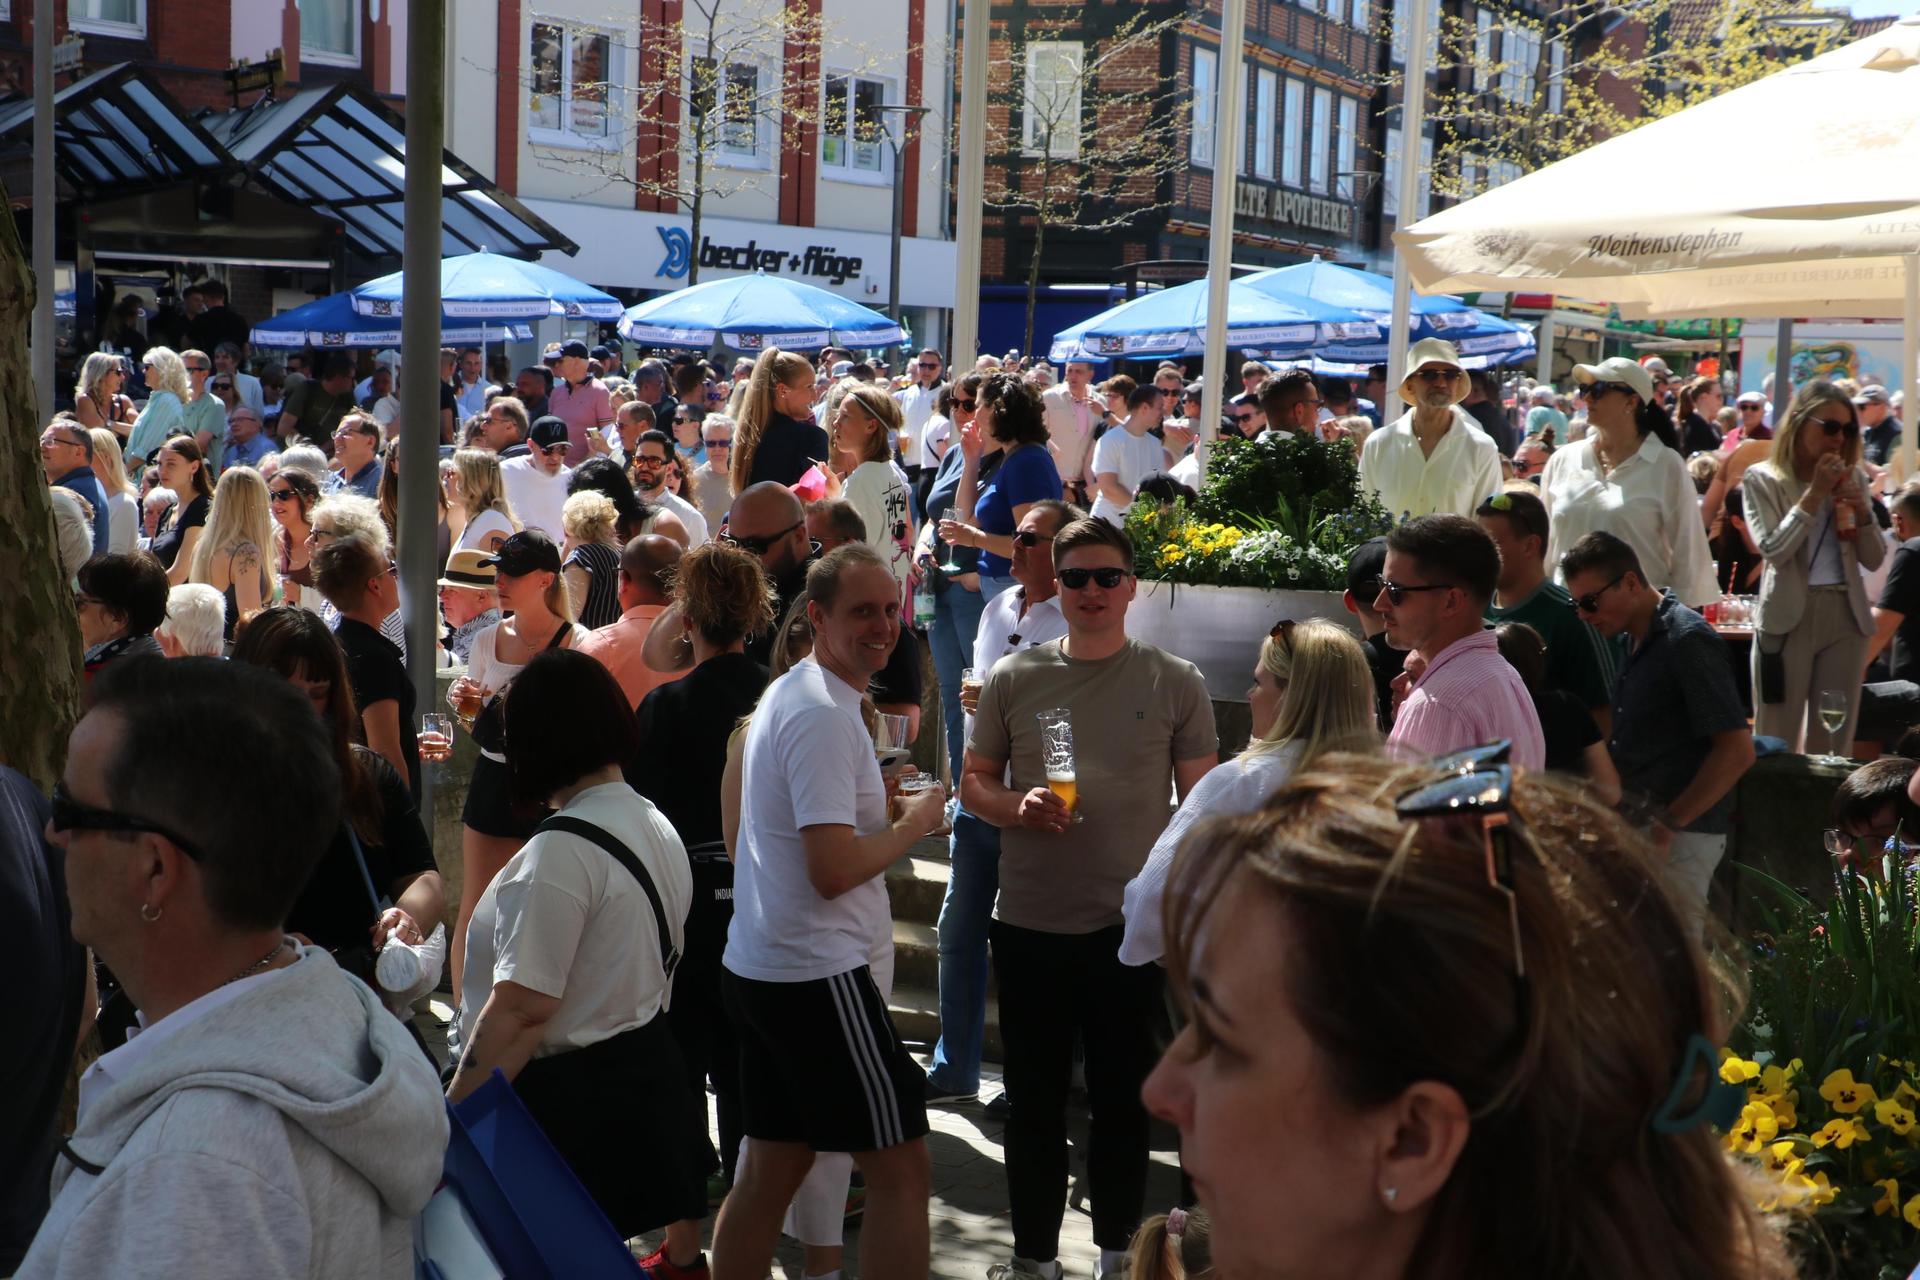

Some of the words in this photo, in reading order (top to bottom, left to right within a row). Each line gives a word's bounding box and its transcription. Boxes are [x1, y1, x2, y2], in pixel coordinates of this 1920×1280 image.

[1274, 189, 1350, 233] APOTHEKE
[1588, 227, 1743, 258] Weihenstephan
[715, 888, 735, 900] INDIA
